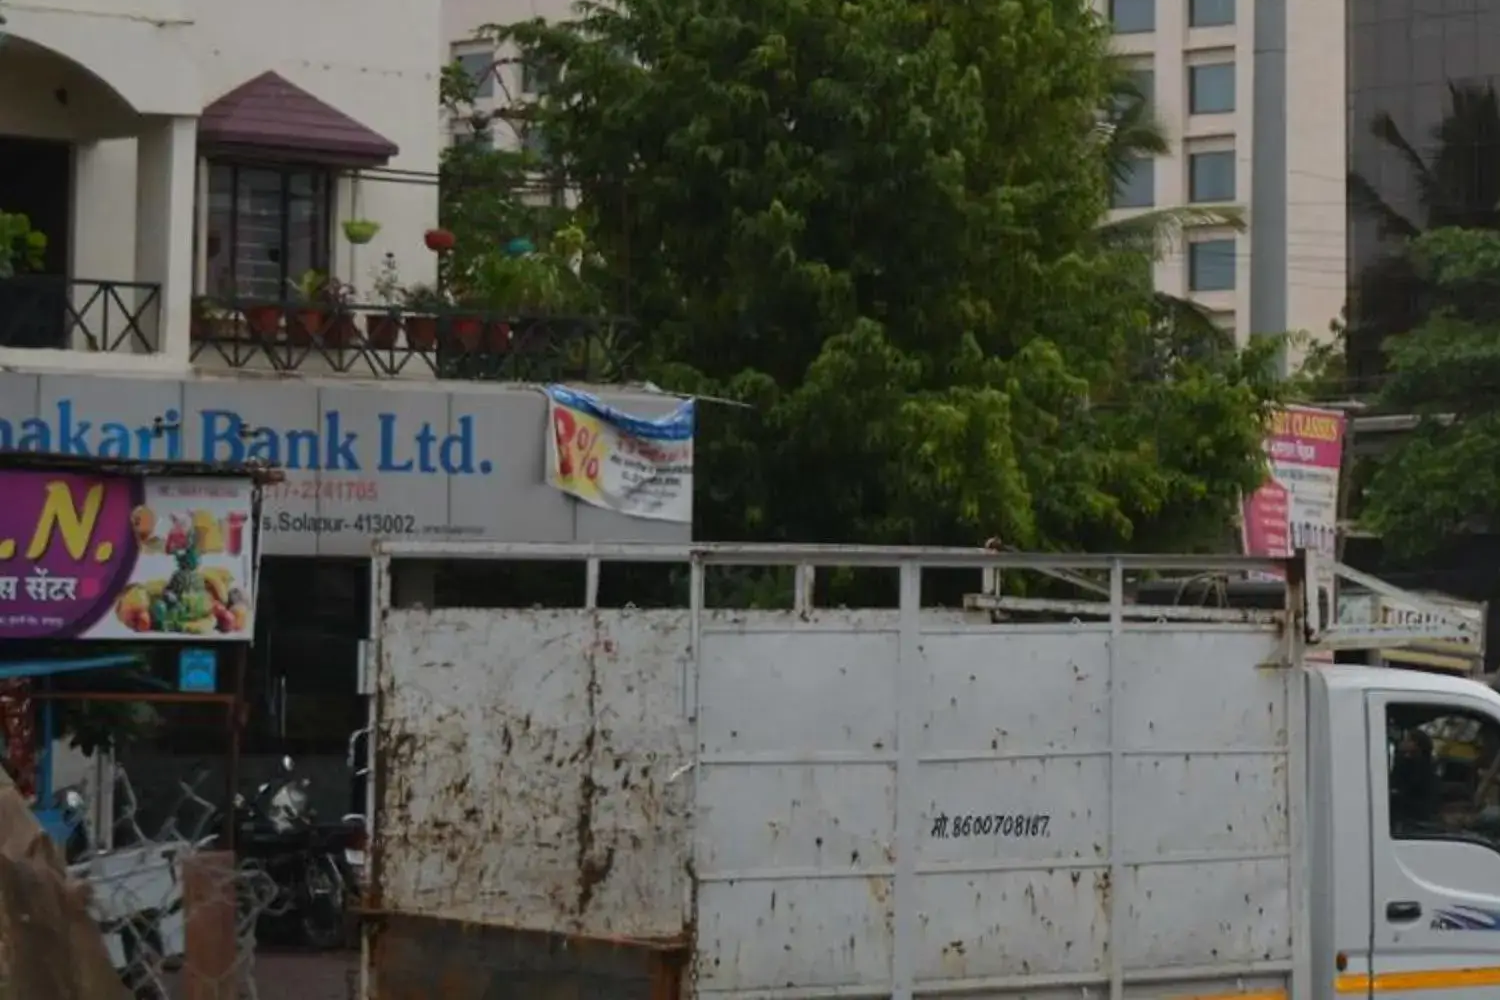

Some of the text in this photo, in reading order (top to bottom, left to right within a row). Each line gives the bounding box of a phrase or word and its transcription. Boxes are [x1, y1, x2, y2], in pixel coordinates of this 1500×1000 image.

[197, 409, 362, 471] Bank
[377, 412, 493, 475] Ltd.
[24, 566, 79, 601] सेंटर
